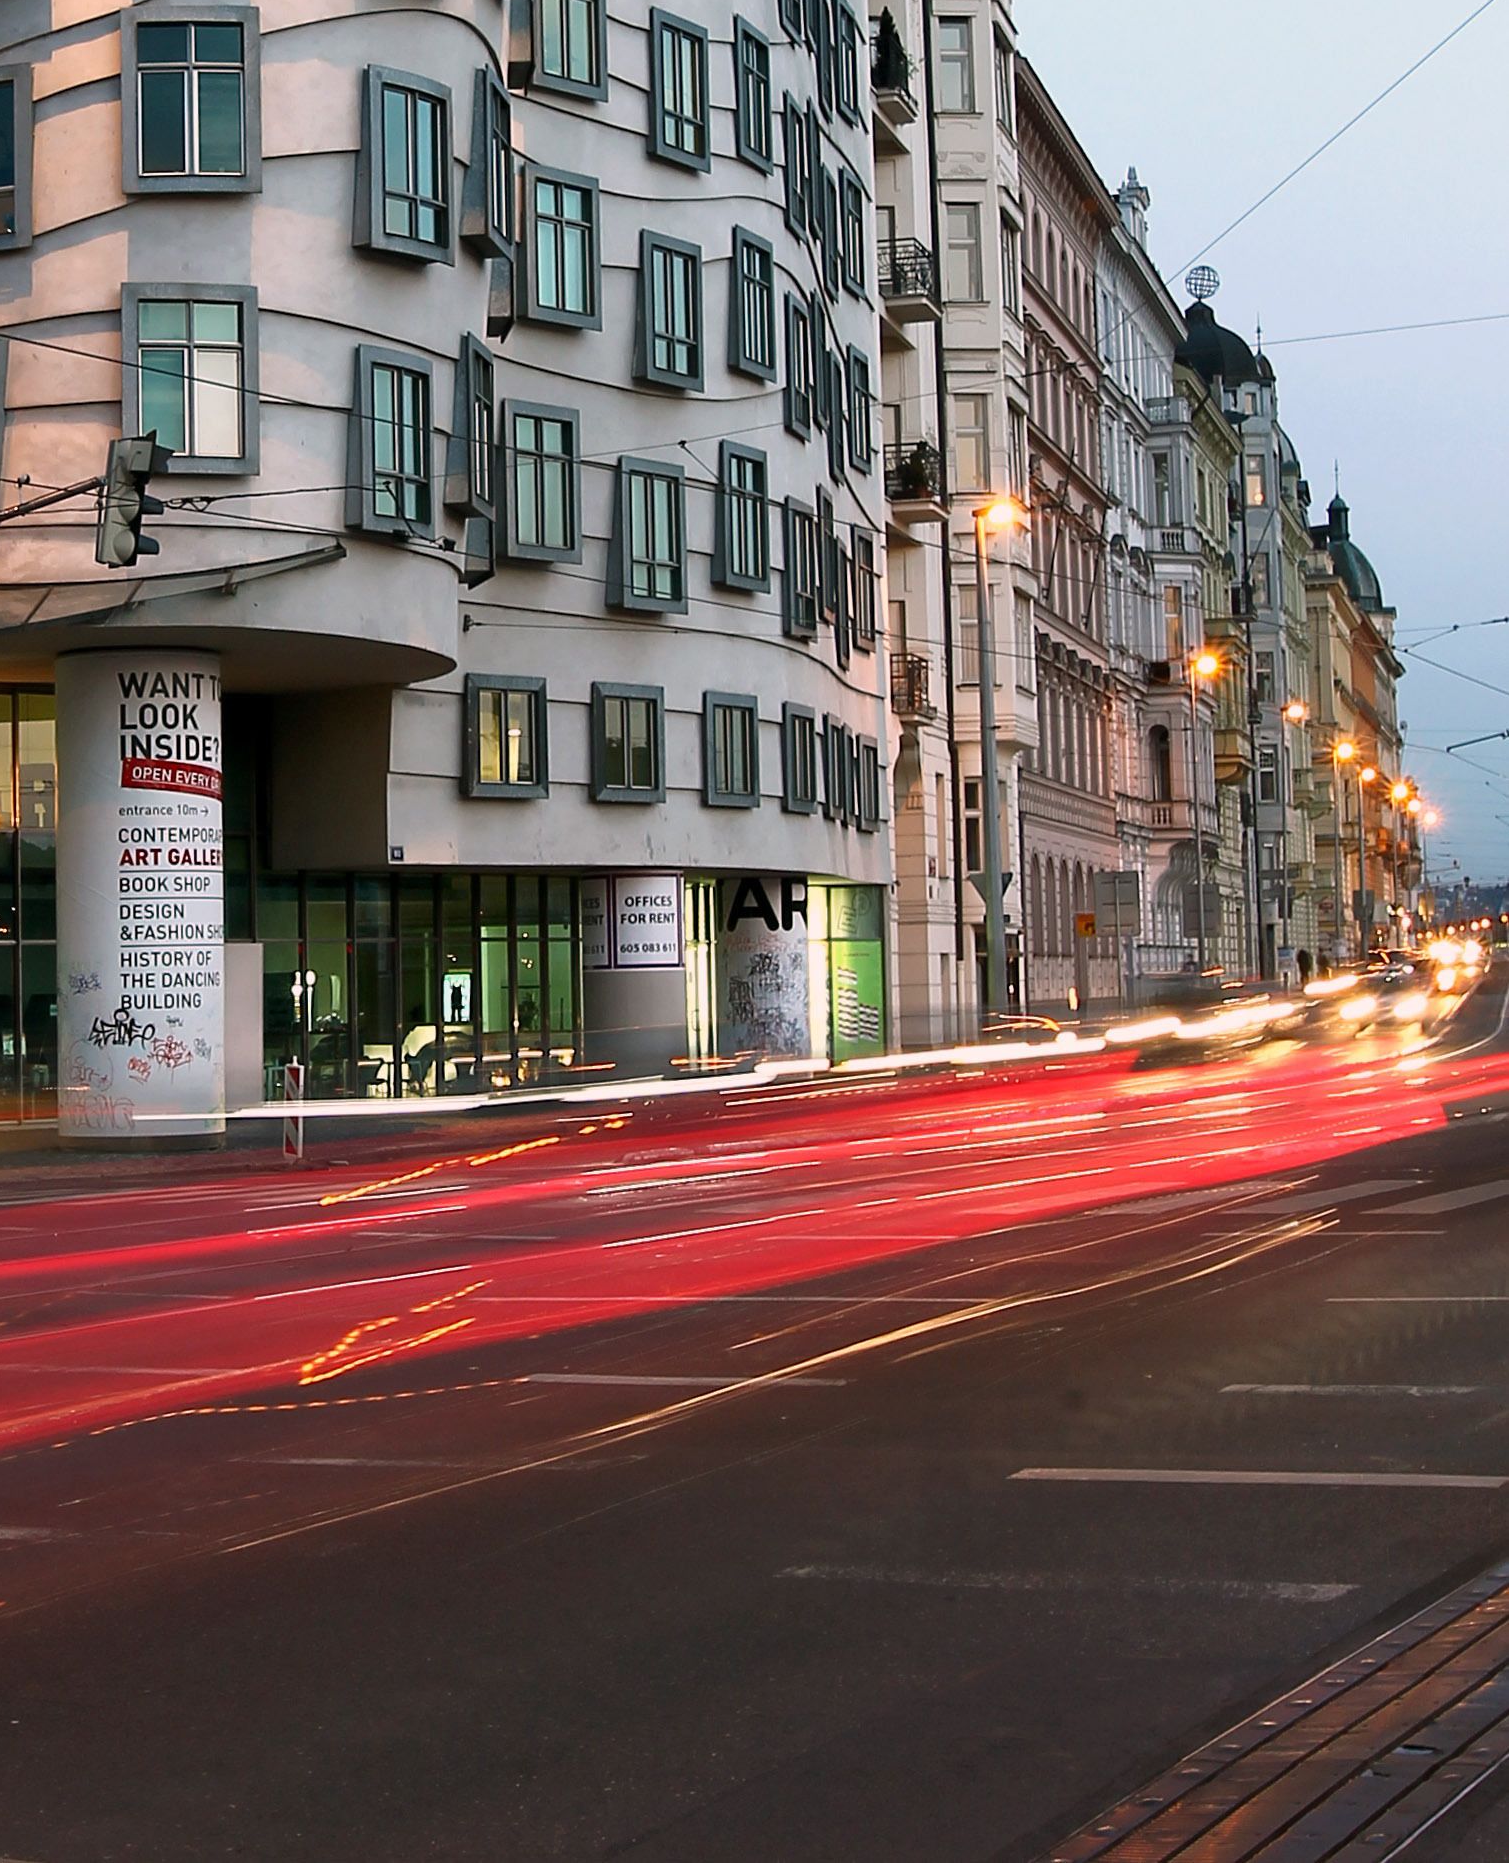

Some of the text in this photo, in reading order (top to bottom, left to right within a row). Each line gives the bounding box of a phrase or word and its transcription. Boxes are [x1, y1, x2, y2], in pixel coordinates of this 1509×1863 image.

[118, 672, 204, 699] WANT
[120, 704, 199, 730] LOOK
[120, 734, 219, 763] INSIDE?
[132, 766, 172, 782] OPEN
[176, 770, 210, 787] EVERY
[119, 804, 198, 817] entrance 10m
[119, 848, 222, 866] ART GALLER
[119, 876, 210, 892] BOOK SHOP
[624, 896, 672, 907] OFFICES
[120, 904, 185, 920] DESIGN
[620, 913, 675, 925] FOR RENT
[620, 943, 676, 954] 605 083 611
[120, 950, 213, 967] HISTORY OF
[120, 972, 156, 989] THE
[162, 971, 221, 988] DANCING
[121, 993, 202, 1010] BUILDING
